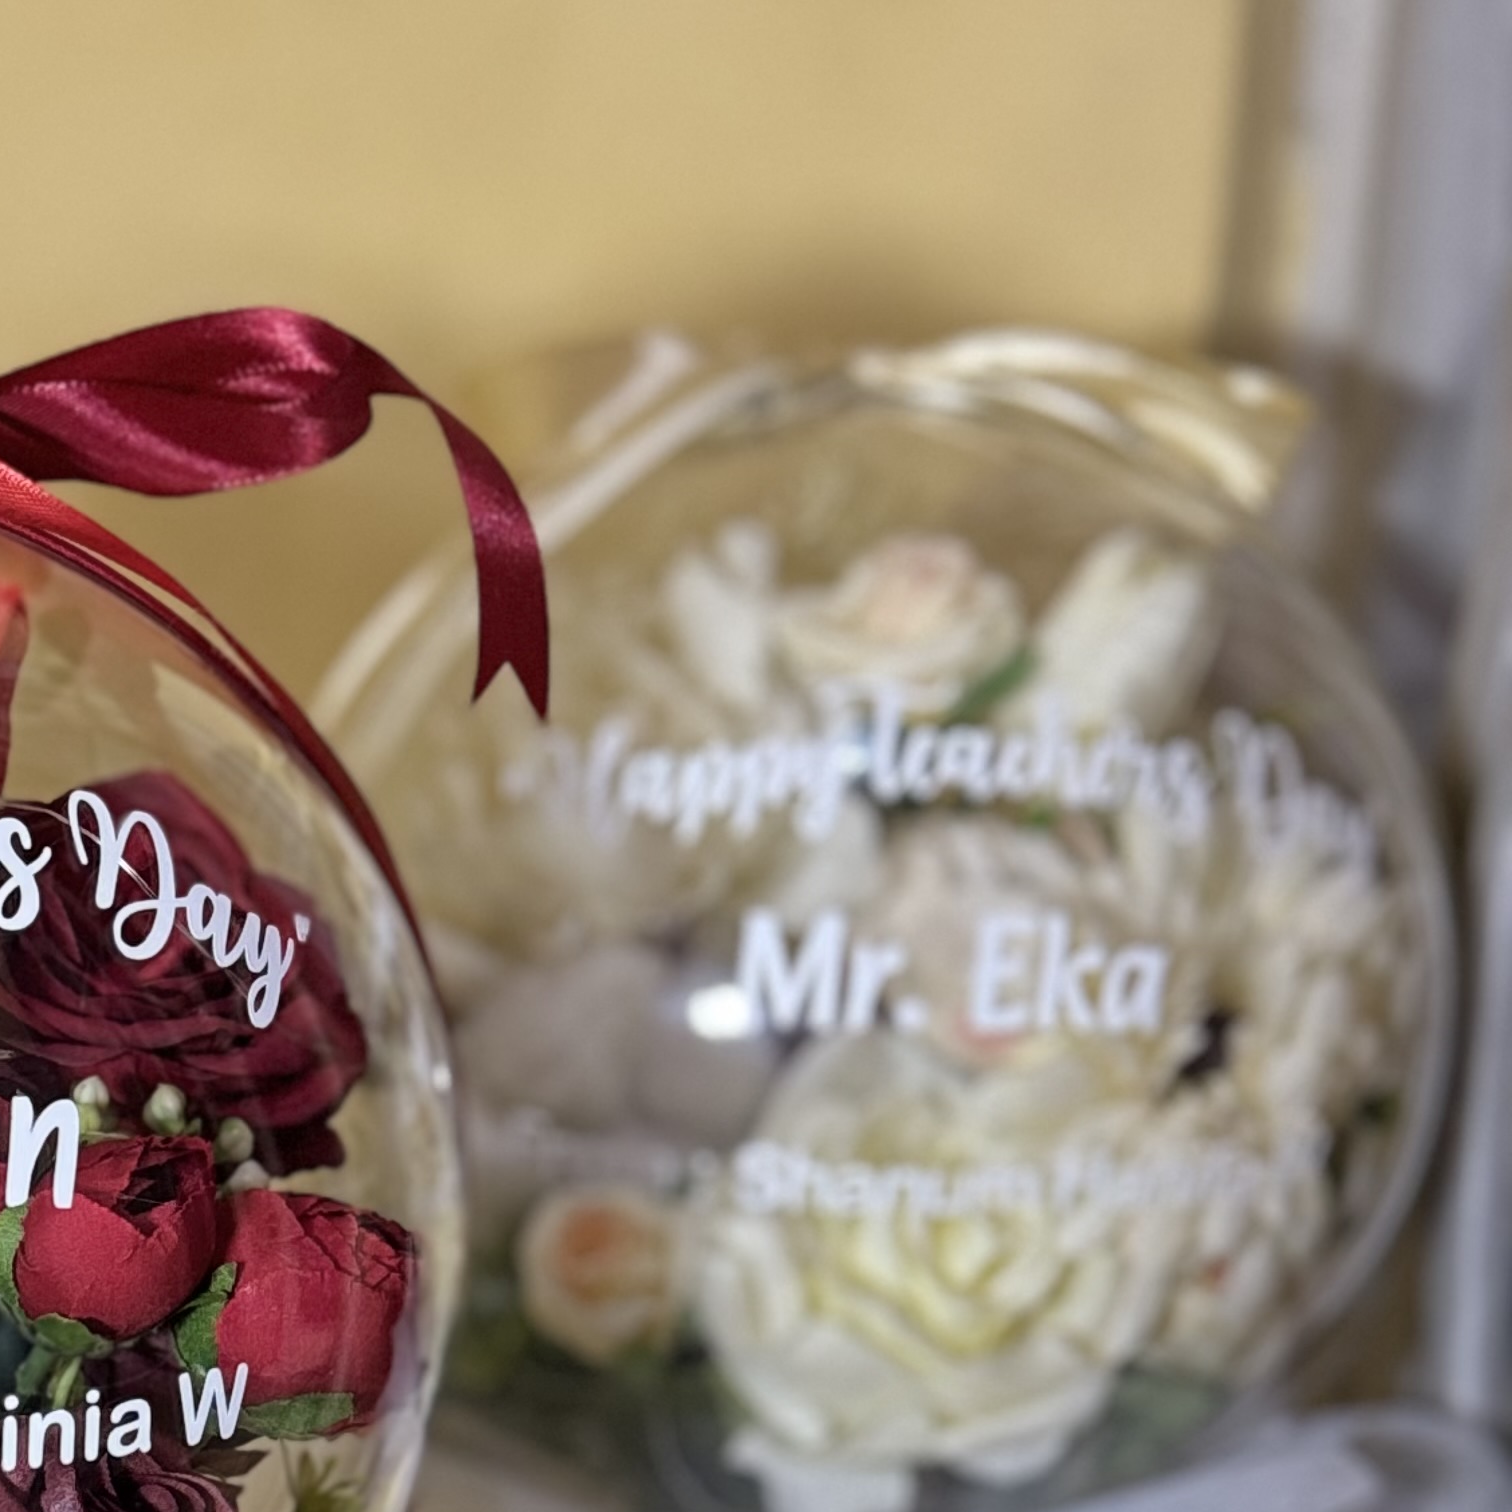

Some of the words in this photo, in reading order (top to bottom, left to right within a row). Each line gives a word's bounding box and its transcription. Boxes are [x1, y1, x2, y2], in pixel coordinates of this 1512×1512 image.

[734, 906, 926, 1034] Mr.
[965, 908, 1169, 1034] Eka
[177, 1361, 249, 1448] W
